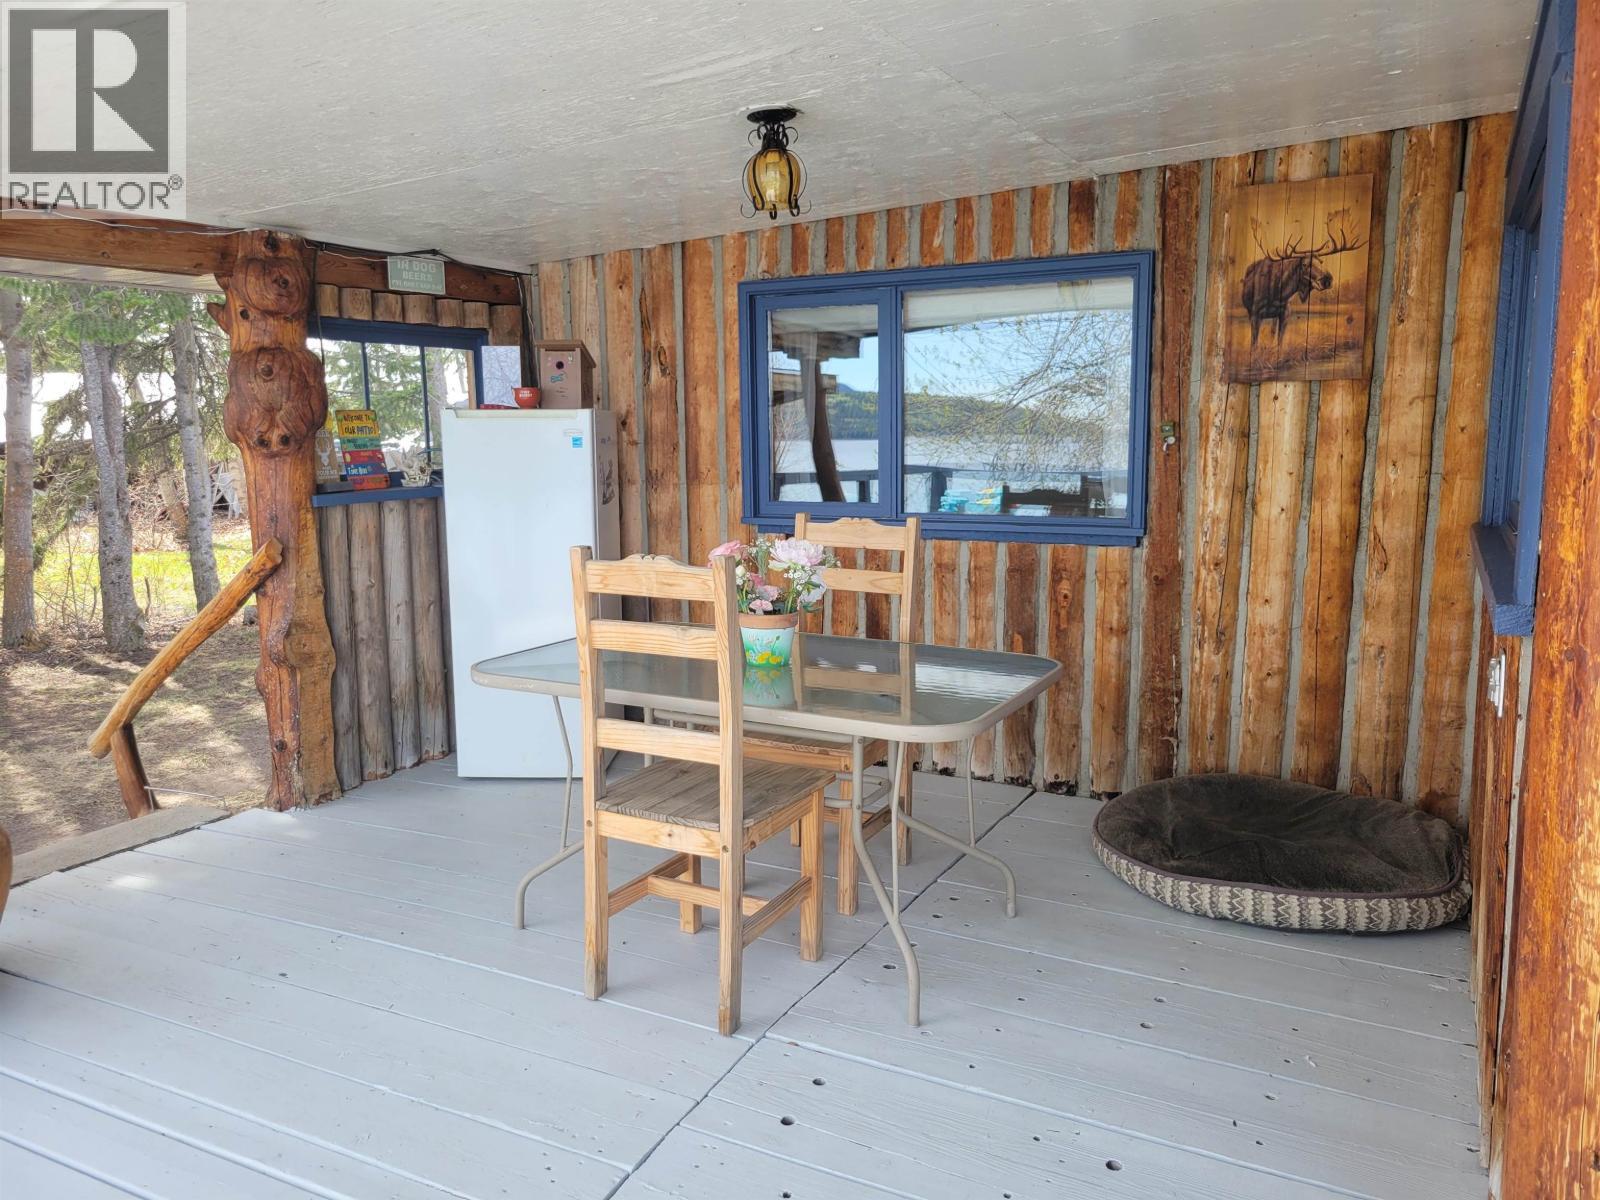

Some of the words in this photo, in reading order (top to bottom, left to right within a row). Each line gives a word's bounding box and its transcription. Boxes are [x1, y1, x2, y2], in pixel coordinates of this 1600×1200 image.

[413, 261, 436, 273] DOG
[402, 271, 433, 282] BEERS
[343, 414, 364, 423] WELCOME
[344, 425, 356, 434] OUR
